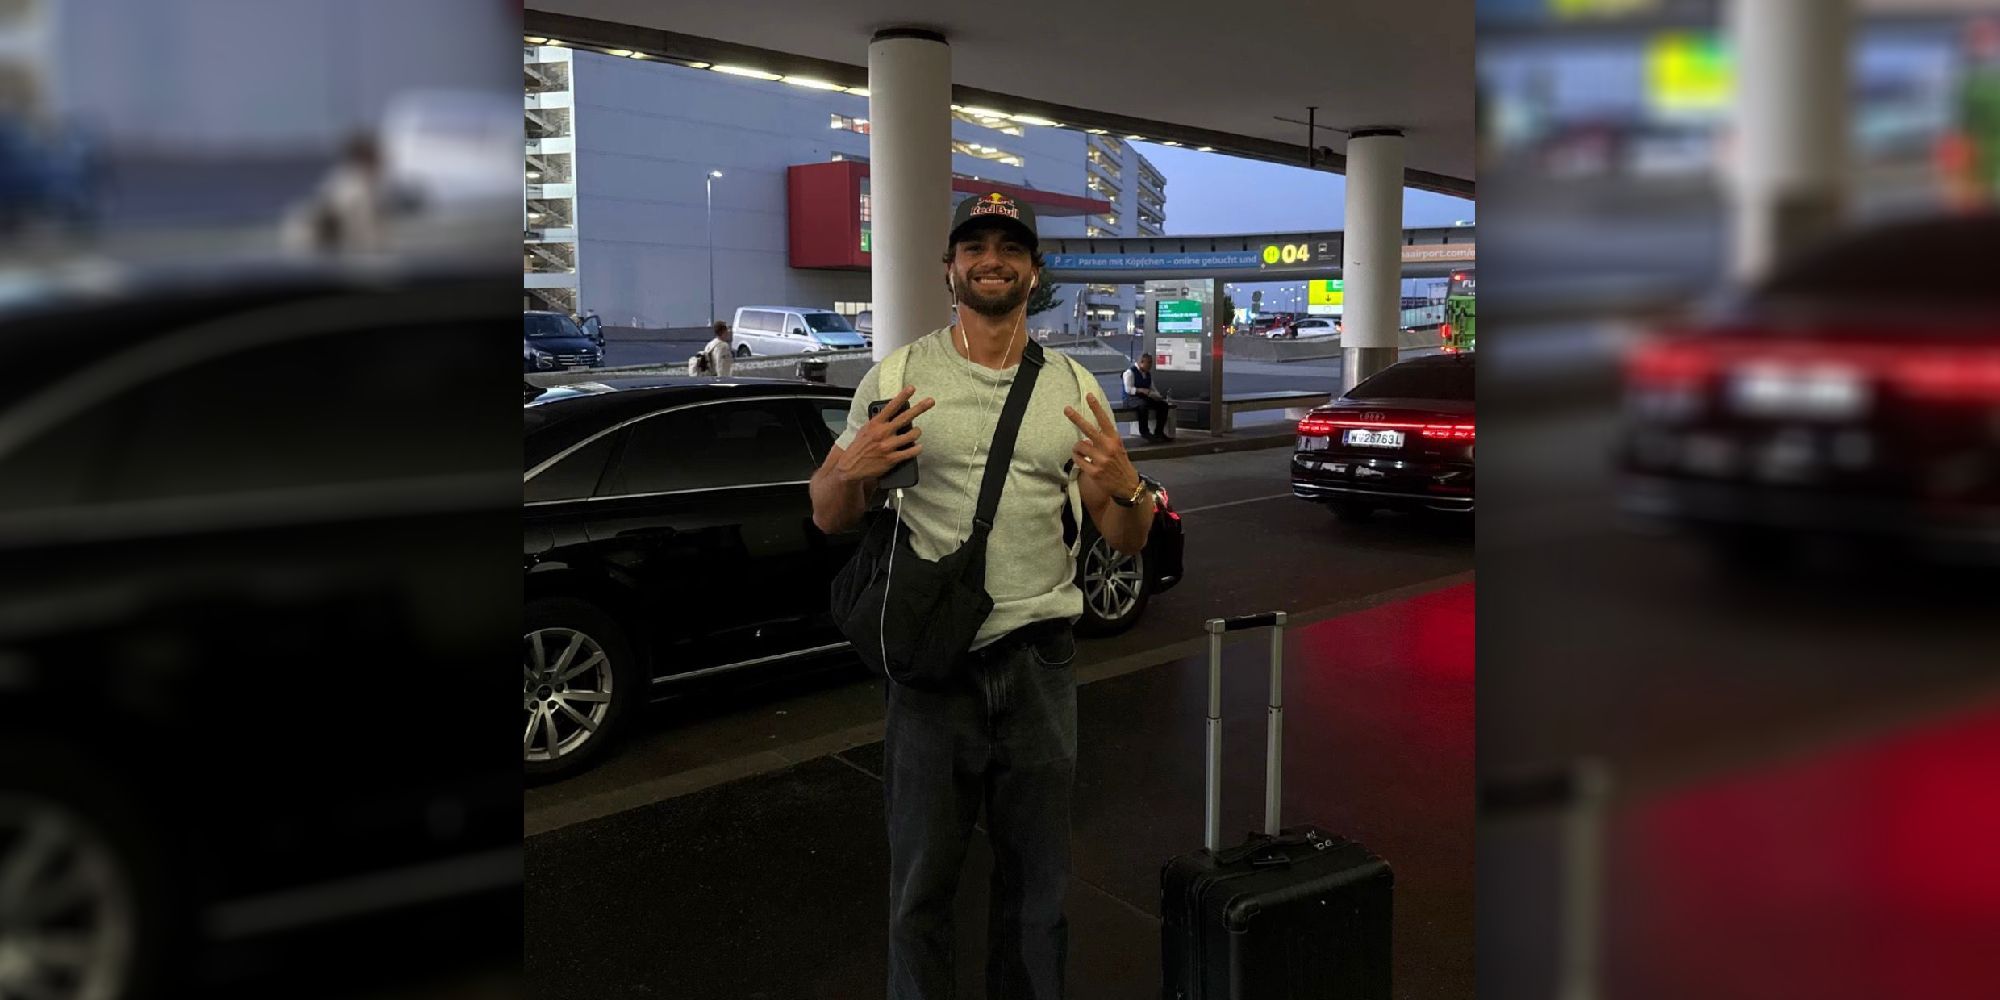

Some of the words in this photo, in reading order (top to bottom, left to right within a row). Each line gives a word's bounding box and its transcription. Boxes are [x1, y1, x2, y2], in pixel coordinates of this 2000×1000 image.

[970, 204, 996, 216] Red
[996, 204, 1019, 219] Bull
[1079, 258, 1107, 266] Parken
[1109, 257, 1124, 266] mit
[1125, 256, 1165, 268] Köpfchen
[1173, 256, 1200, 265] online
[1201, 255, 1238, 267] gebucht
[1239, 254, 1257, 264] und
[1281, 244, 1310, 264] 04
[1351, 433, 1359, 443] W
